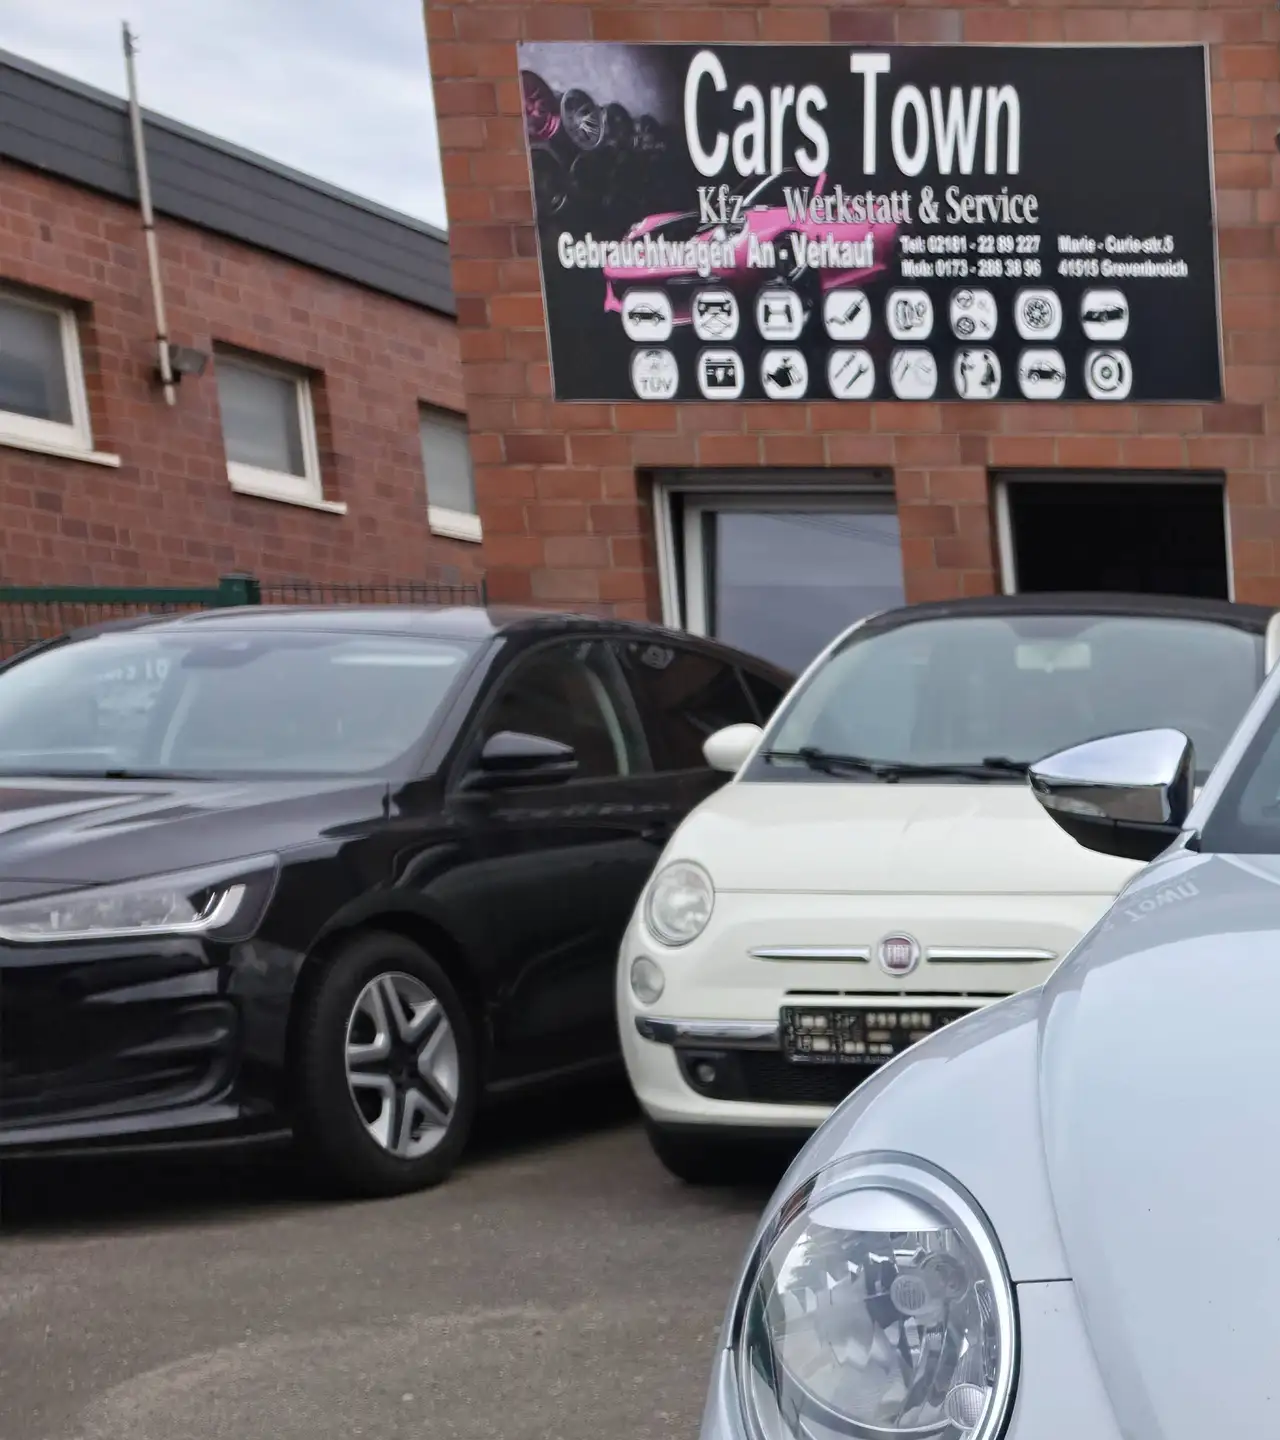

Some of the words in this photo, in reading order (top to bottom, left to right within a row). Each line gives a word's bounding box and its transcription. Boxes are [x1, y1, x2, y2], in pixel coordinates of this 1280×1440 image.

[684, 50, 830, 177] Cars
[850, 53, 1021, 177] Town
[697, 184, 747, 224] Kfz
[782, 184, 913, 224] Werkstatt
[918, 185, 941, 224] &
[945, 185, 1040, 225] Service
[557, 231, 736, 277] Gebrauchtwagen
[746, 231, 776, 269] An
[790, 231, 876, 269] Verkauf
[977, 234, 996, 254] 22
[1015, 234, 1041, 254] 227
[934, 258, 968, 278] 0173
